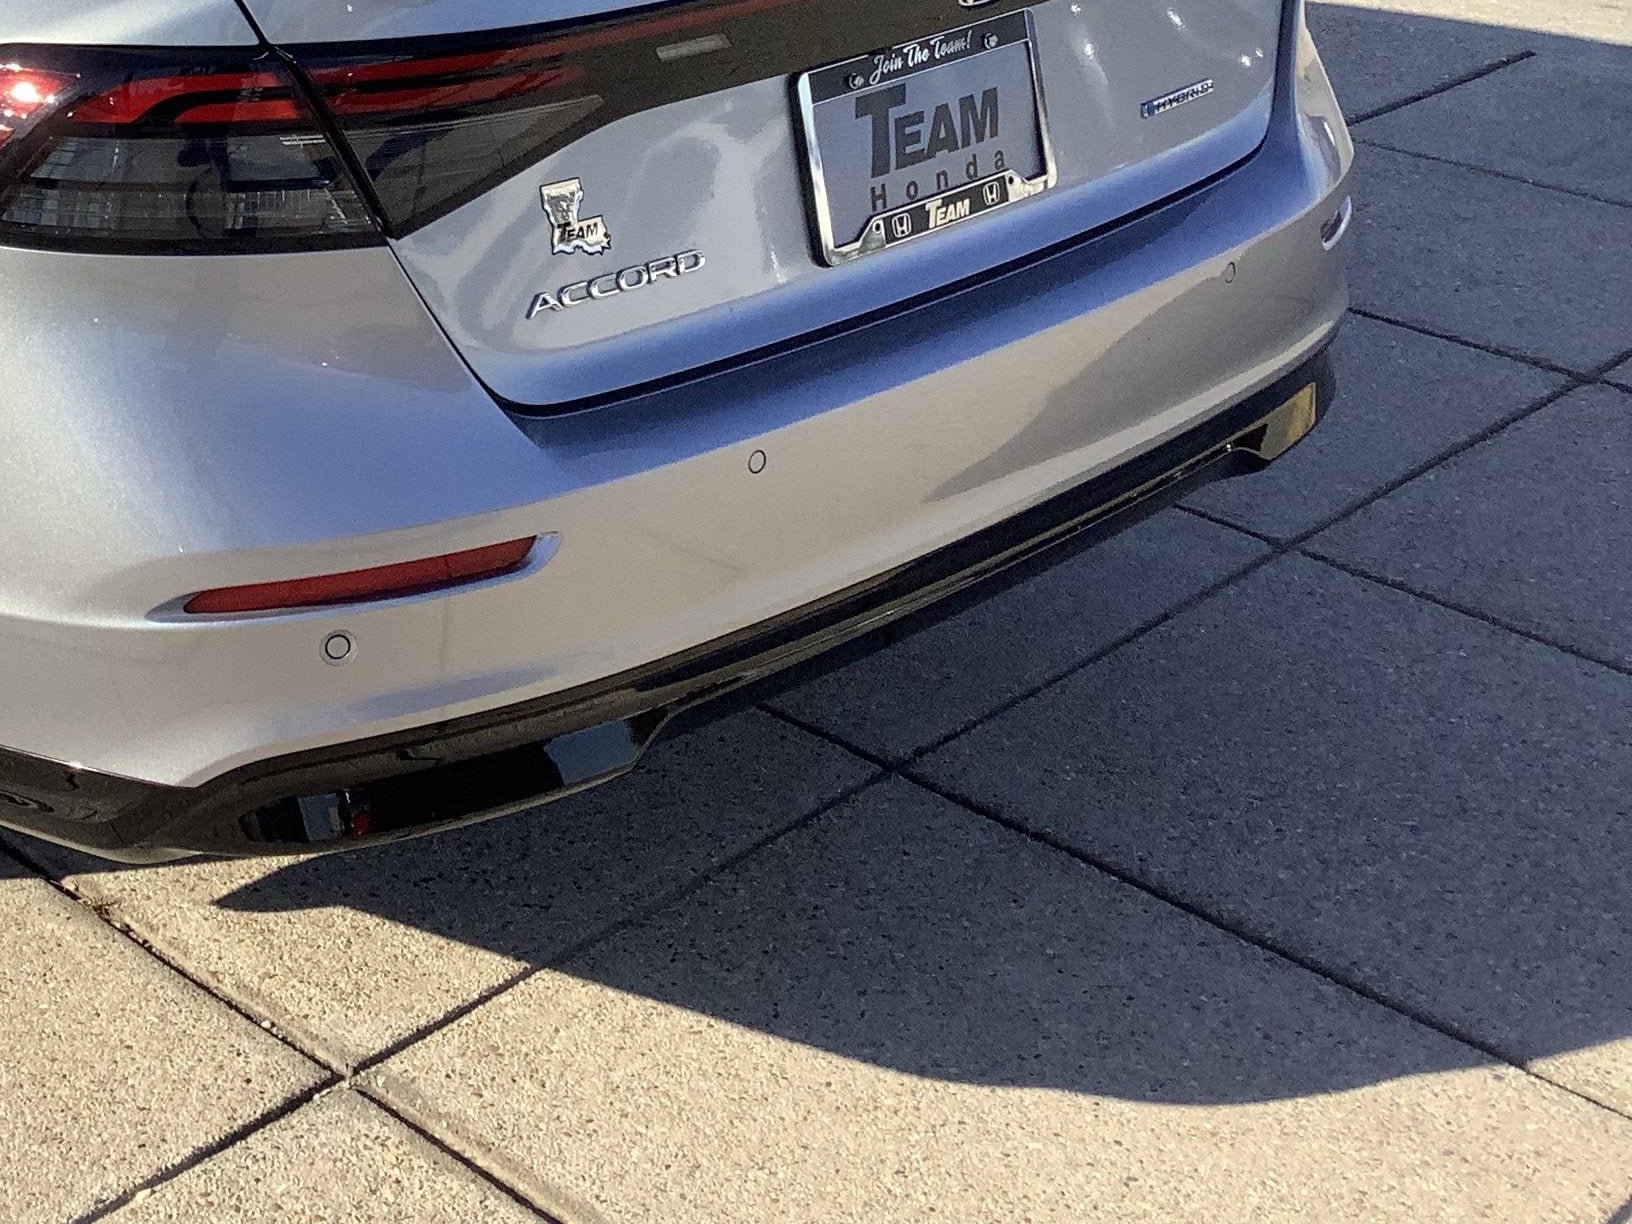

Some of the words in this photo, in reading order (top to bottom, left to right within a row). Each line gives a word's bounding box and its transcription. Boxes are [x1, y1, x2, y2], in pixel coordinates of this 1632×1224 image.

[868, 53, 904, 85] Join
[902, 43, 929, 67] The
[929, 29, 973, 59] Team!
[854, 82, 1000, 179] TEAM
[870, 149, 1006, 213] Honda
[556, 221, 599, 245] TEAM
[924, 198, 971, 229] TEAM
[525, 249, 706, 319] ACCORD
